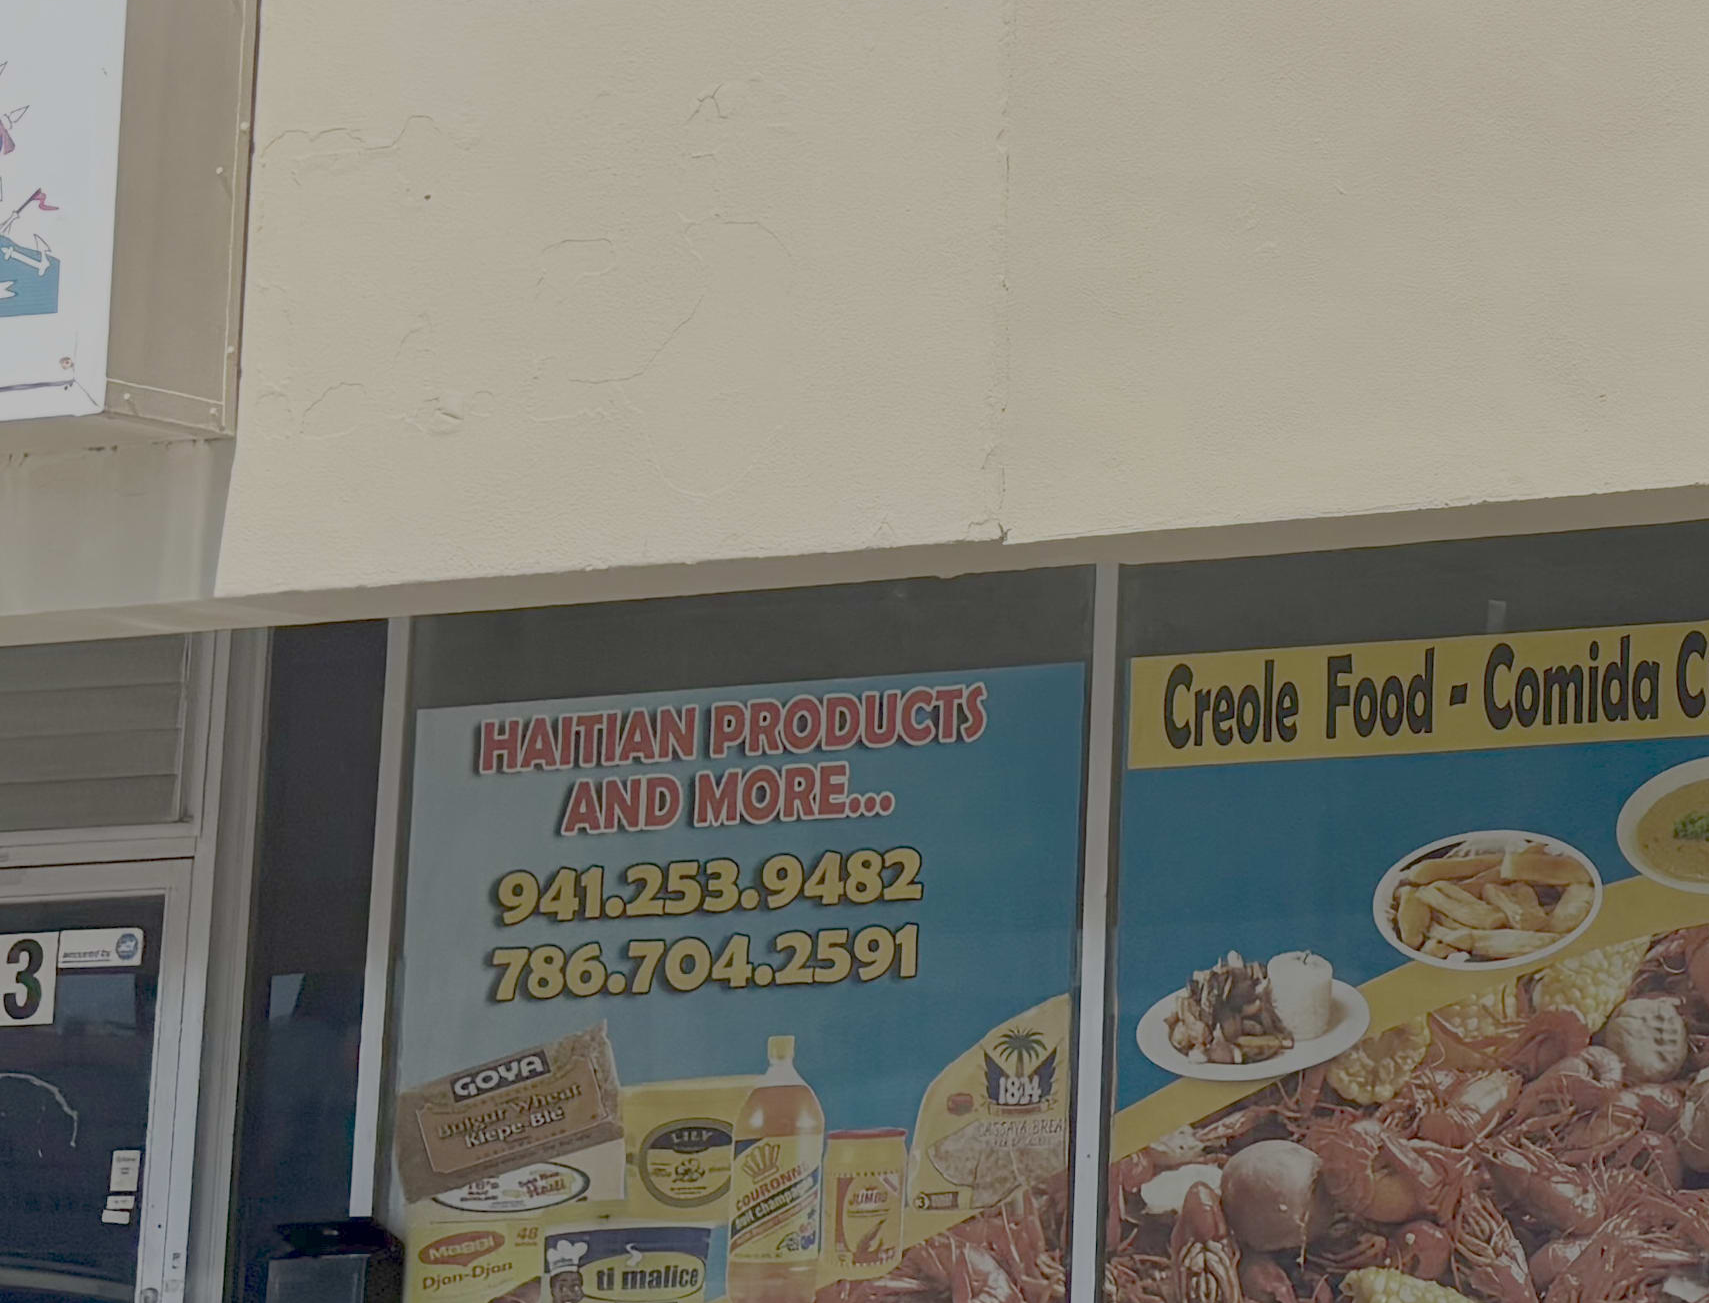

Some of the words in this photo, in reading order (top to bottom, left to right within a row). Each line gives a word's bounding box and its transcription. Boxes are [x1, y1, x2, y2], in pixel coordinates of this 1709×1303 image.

[479, 705, 698, 774] HAITIAN
[710, 683, 988, 759] PRODUCTS
[1164, 660, 1298, 749] Creole
[1326, 647, 1435, 739] Food
[1484, 635, 1660, 730] Comida
[561, 774, 682, 836] AND
[694, 761, 895, 827] MORE...
[498, 846, 924, 925] 941.253.9482
[4, 939, 43, 1019] 3
[491, 923, 919, 1001] 786.704.2591
[454, 1056, 544, 1097] GOYA
[671, 1130, 713, 1143] LILY
[622, 1265, 699, 1290] malice
